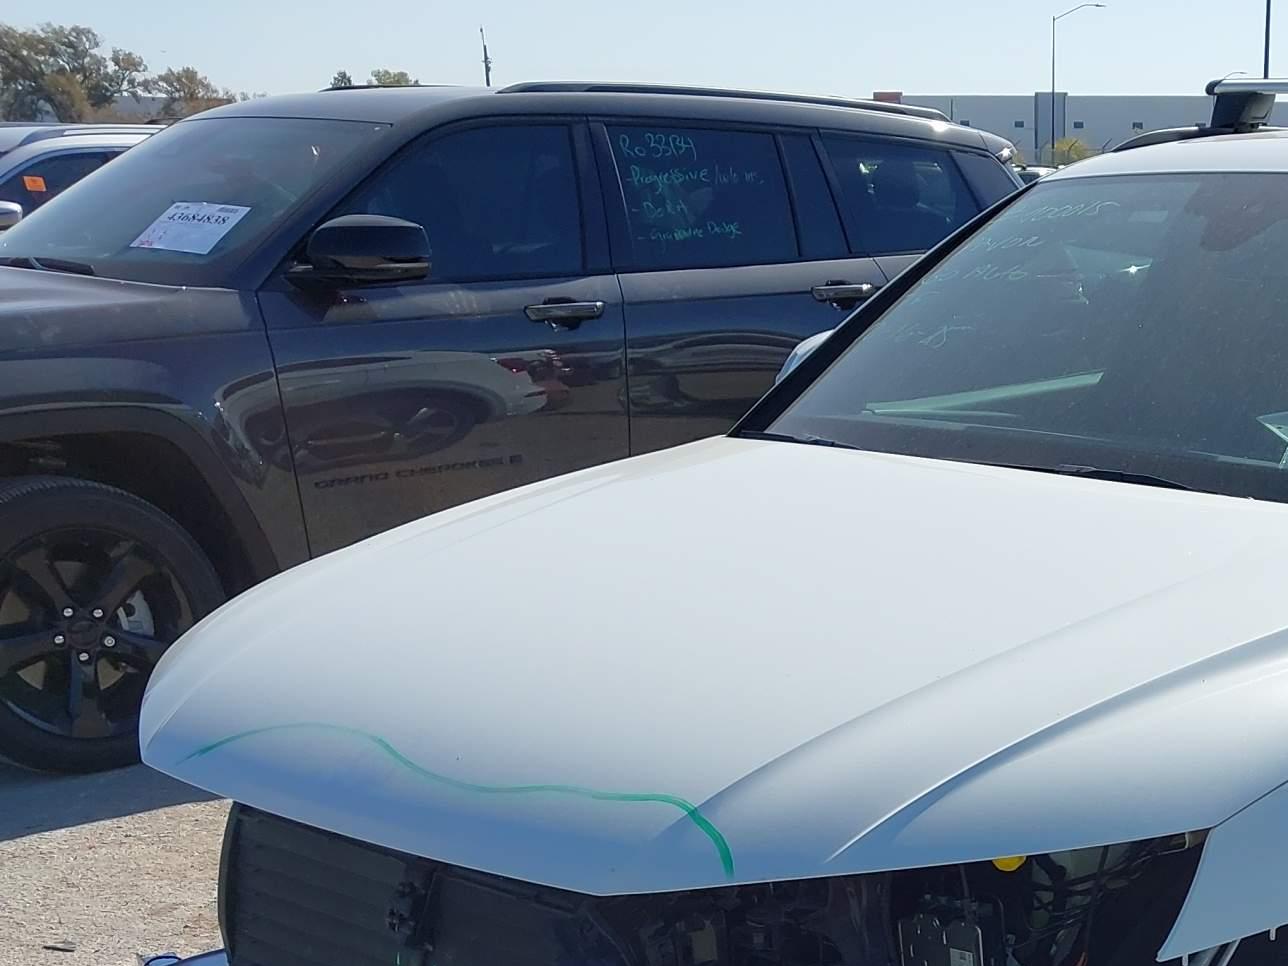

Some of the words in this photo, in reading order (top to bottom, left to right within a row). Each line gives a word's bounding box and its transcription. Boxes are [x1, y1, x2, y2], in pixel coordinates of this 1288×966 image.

[167, 211, 230, 225] 43684838
[314, 471, 389, 489] GRAND
[395, 456, 505, 478] CHEROKEE
